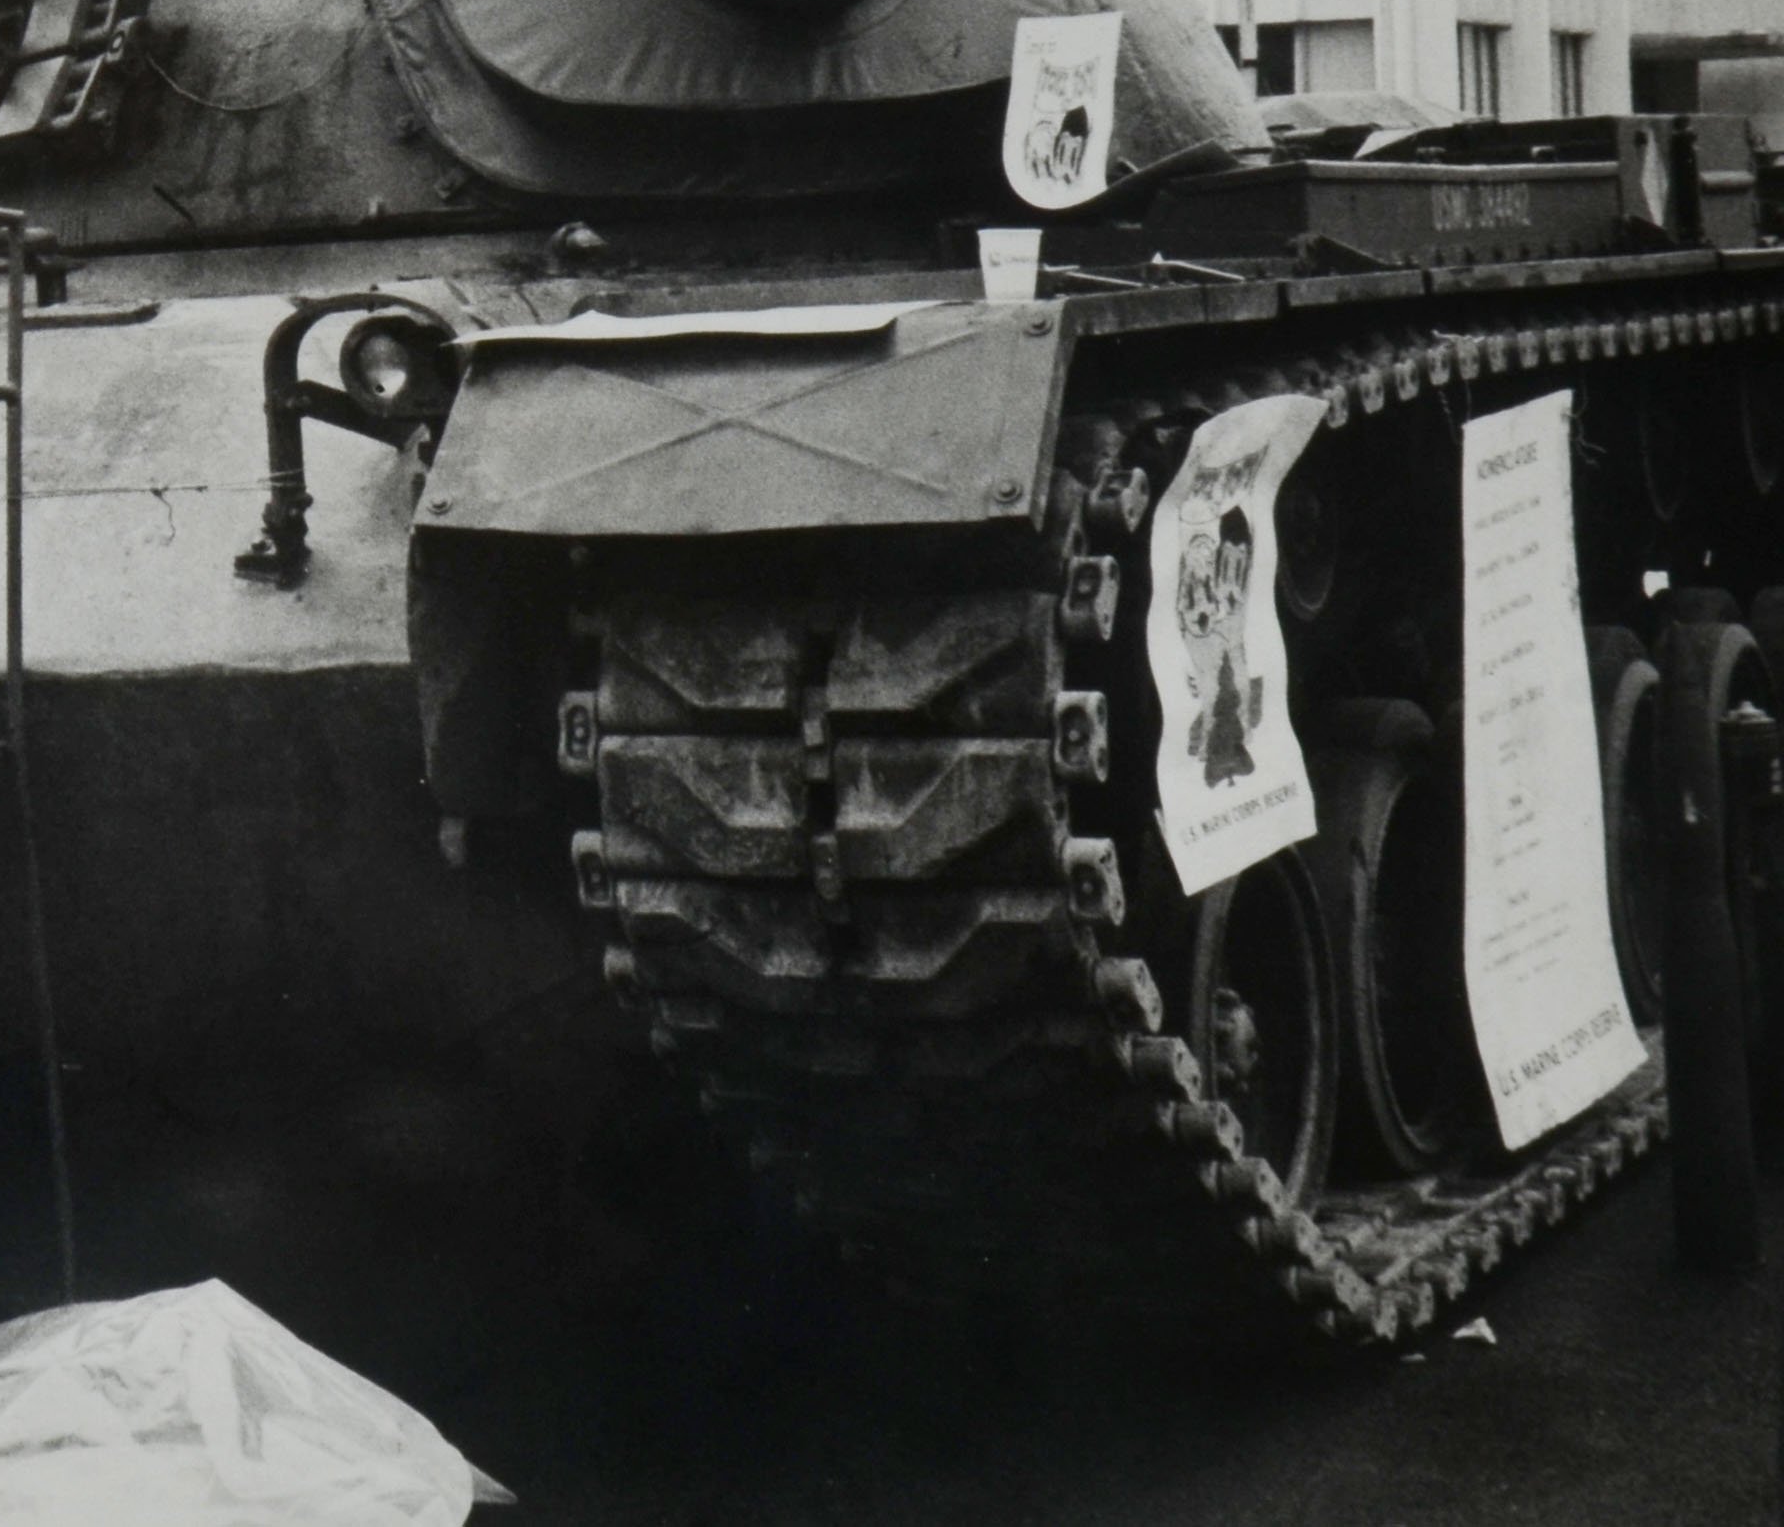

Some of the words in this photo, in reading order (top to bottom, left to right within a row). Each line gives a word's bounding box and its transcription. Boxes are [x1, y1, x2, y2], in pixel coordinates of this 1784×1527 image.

[1231, 798, 1263, 823] CORPS
[1262, 781, 1299, 810] RESERVE
[1520, 1043, 1562, 1080] MARINE
[1559, 1027, 1593, 1059] CORPS
[1589, 1002, 1623, 1040] RESERVE
